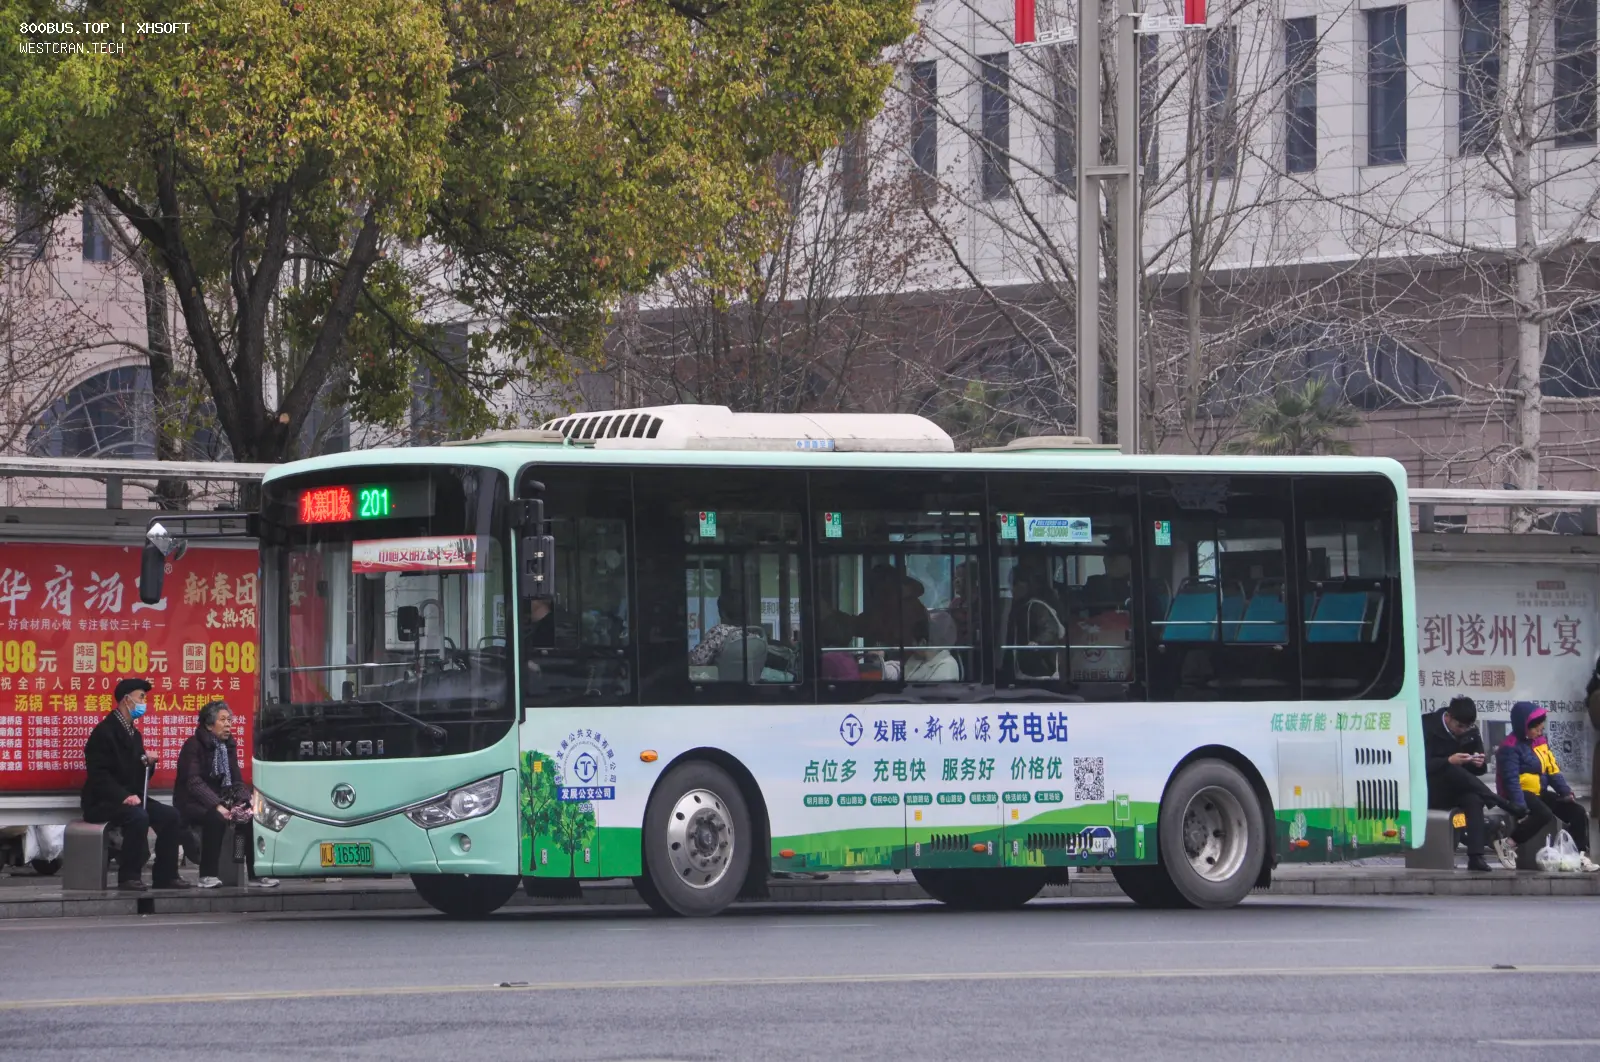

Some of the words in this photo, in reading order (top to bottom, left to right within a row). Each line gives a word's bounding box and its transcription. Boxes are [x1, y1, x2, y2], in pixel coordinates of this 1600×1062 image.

[360, 488, 388, 517] 201
[0, 564, 168, 616] 华府汤
[184, 571, 258, 607] 新春团
[8, 618, 72, 631] 好食材用心做
[78, 619, 152, 631] 专注餐饮三十年
[1417, 613, 1582, 657] 到遂州礼宴
[209, 641, 256, 674] 698
[1431, 669, 1507, 688] 定格人生圆满
[14, 693, 43, 712] 汤锅
[48, 693, 78, 712] 干锅
[83, 693, 113, 712] 套餐
[299, 739, 384, 757] ANKAI
[802, 758, 857, 784] 点位多
[872, 758, 927, 783] 充电快
[941, 757, 996, 782] 服务好
[1010, 755, 1063, 781] 价格优
[561, 787, 612, 800] 发展公交公司
